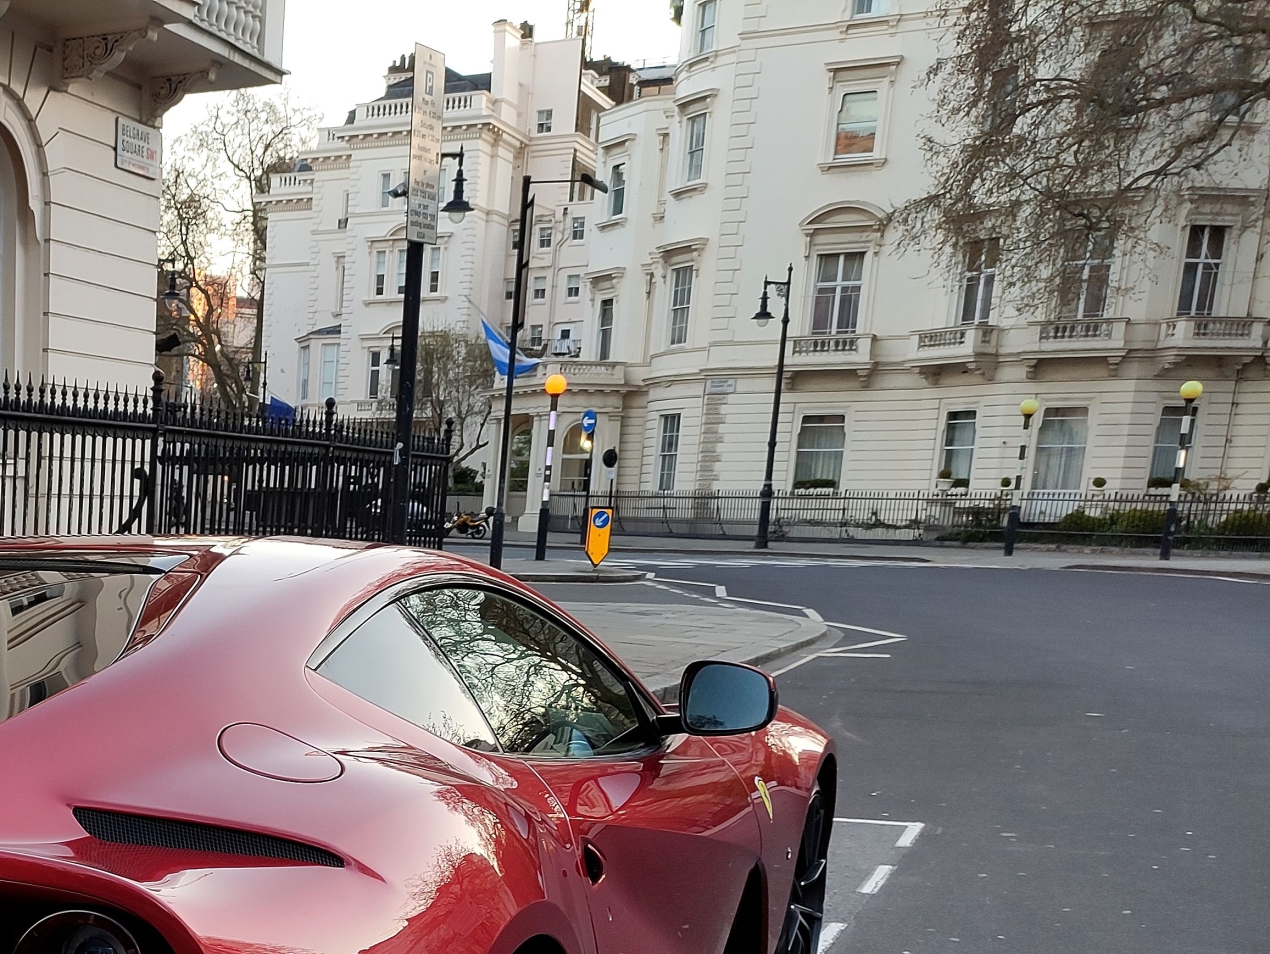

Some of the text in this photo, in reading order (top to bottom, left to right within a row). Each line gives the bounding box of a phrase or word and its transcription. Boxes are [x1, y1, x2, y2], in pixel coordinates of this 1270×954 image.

[121, 124, 150, 145] BELGRAVE
[121, 139, 157, 163] SQUARE SW1
